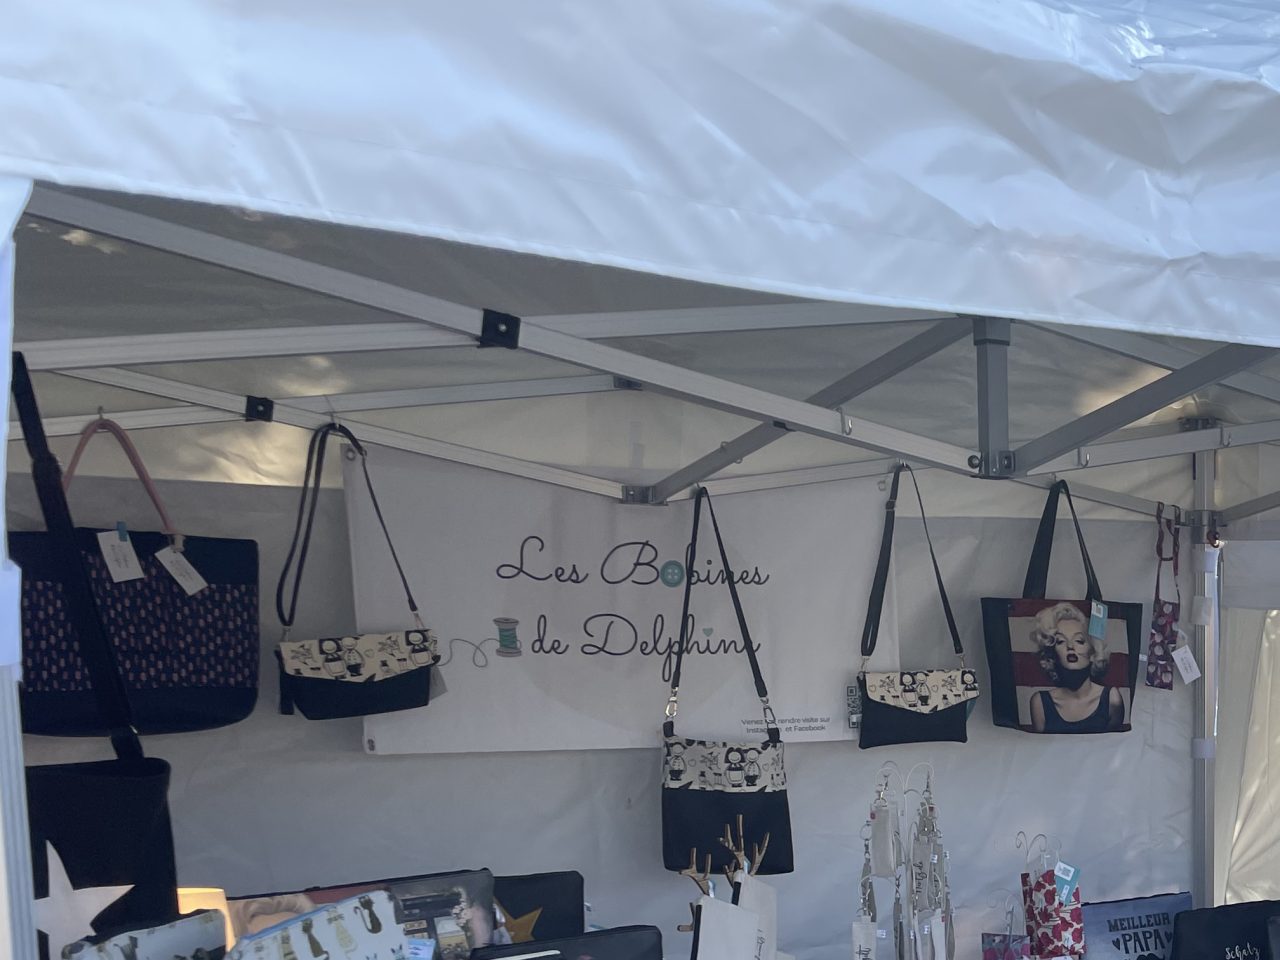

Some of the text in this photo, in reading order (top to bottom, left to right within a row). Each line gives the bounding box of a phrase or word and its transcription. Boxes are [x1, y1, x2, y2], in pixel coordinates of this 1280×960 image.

[496, 535, 589, 583] Les
[531, 614, 569, 654] de
[1107, 912, 1171, 932] MEILLEUR
[1121, 929, 1165, 954] PAPA
